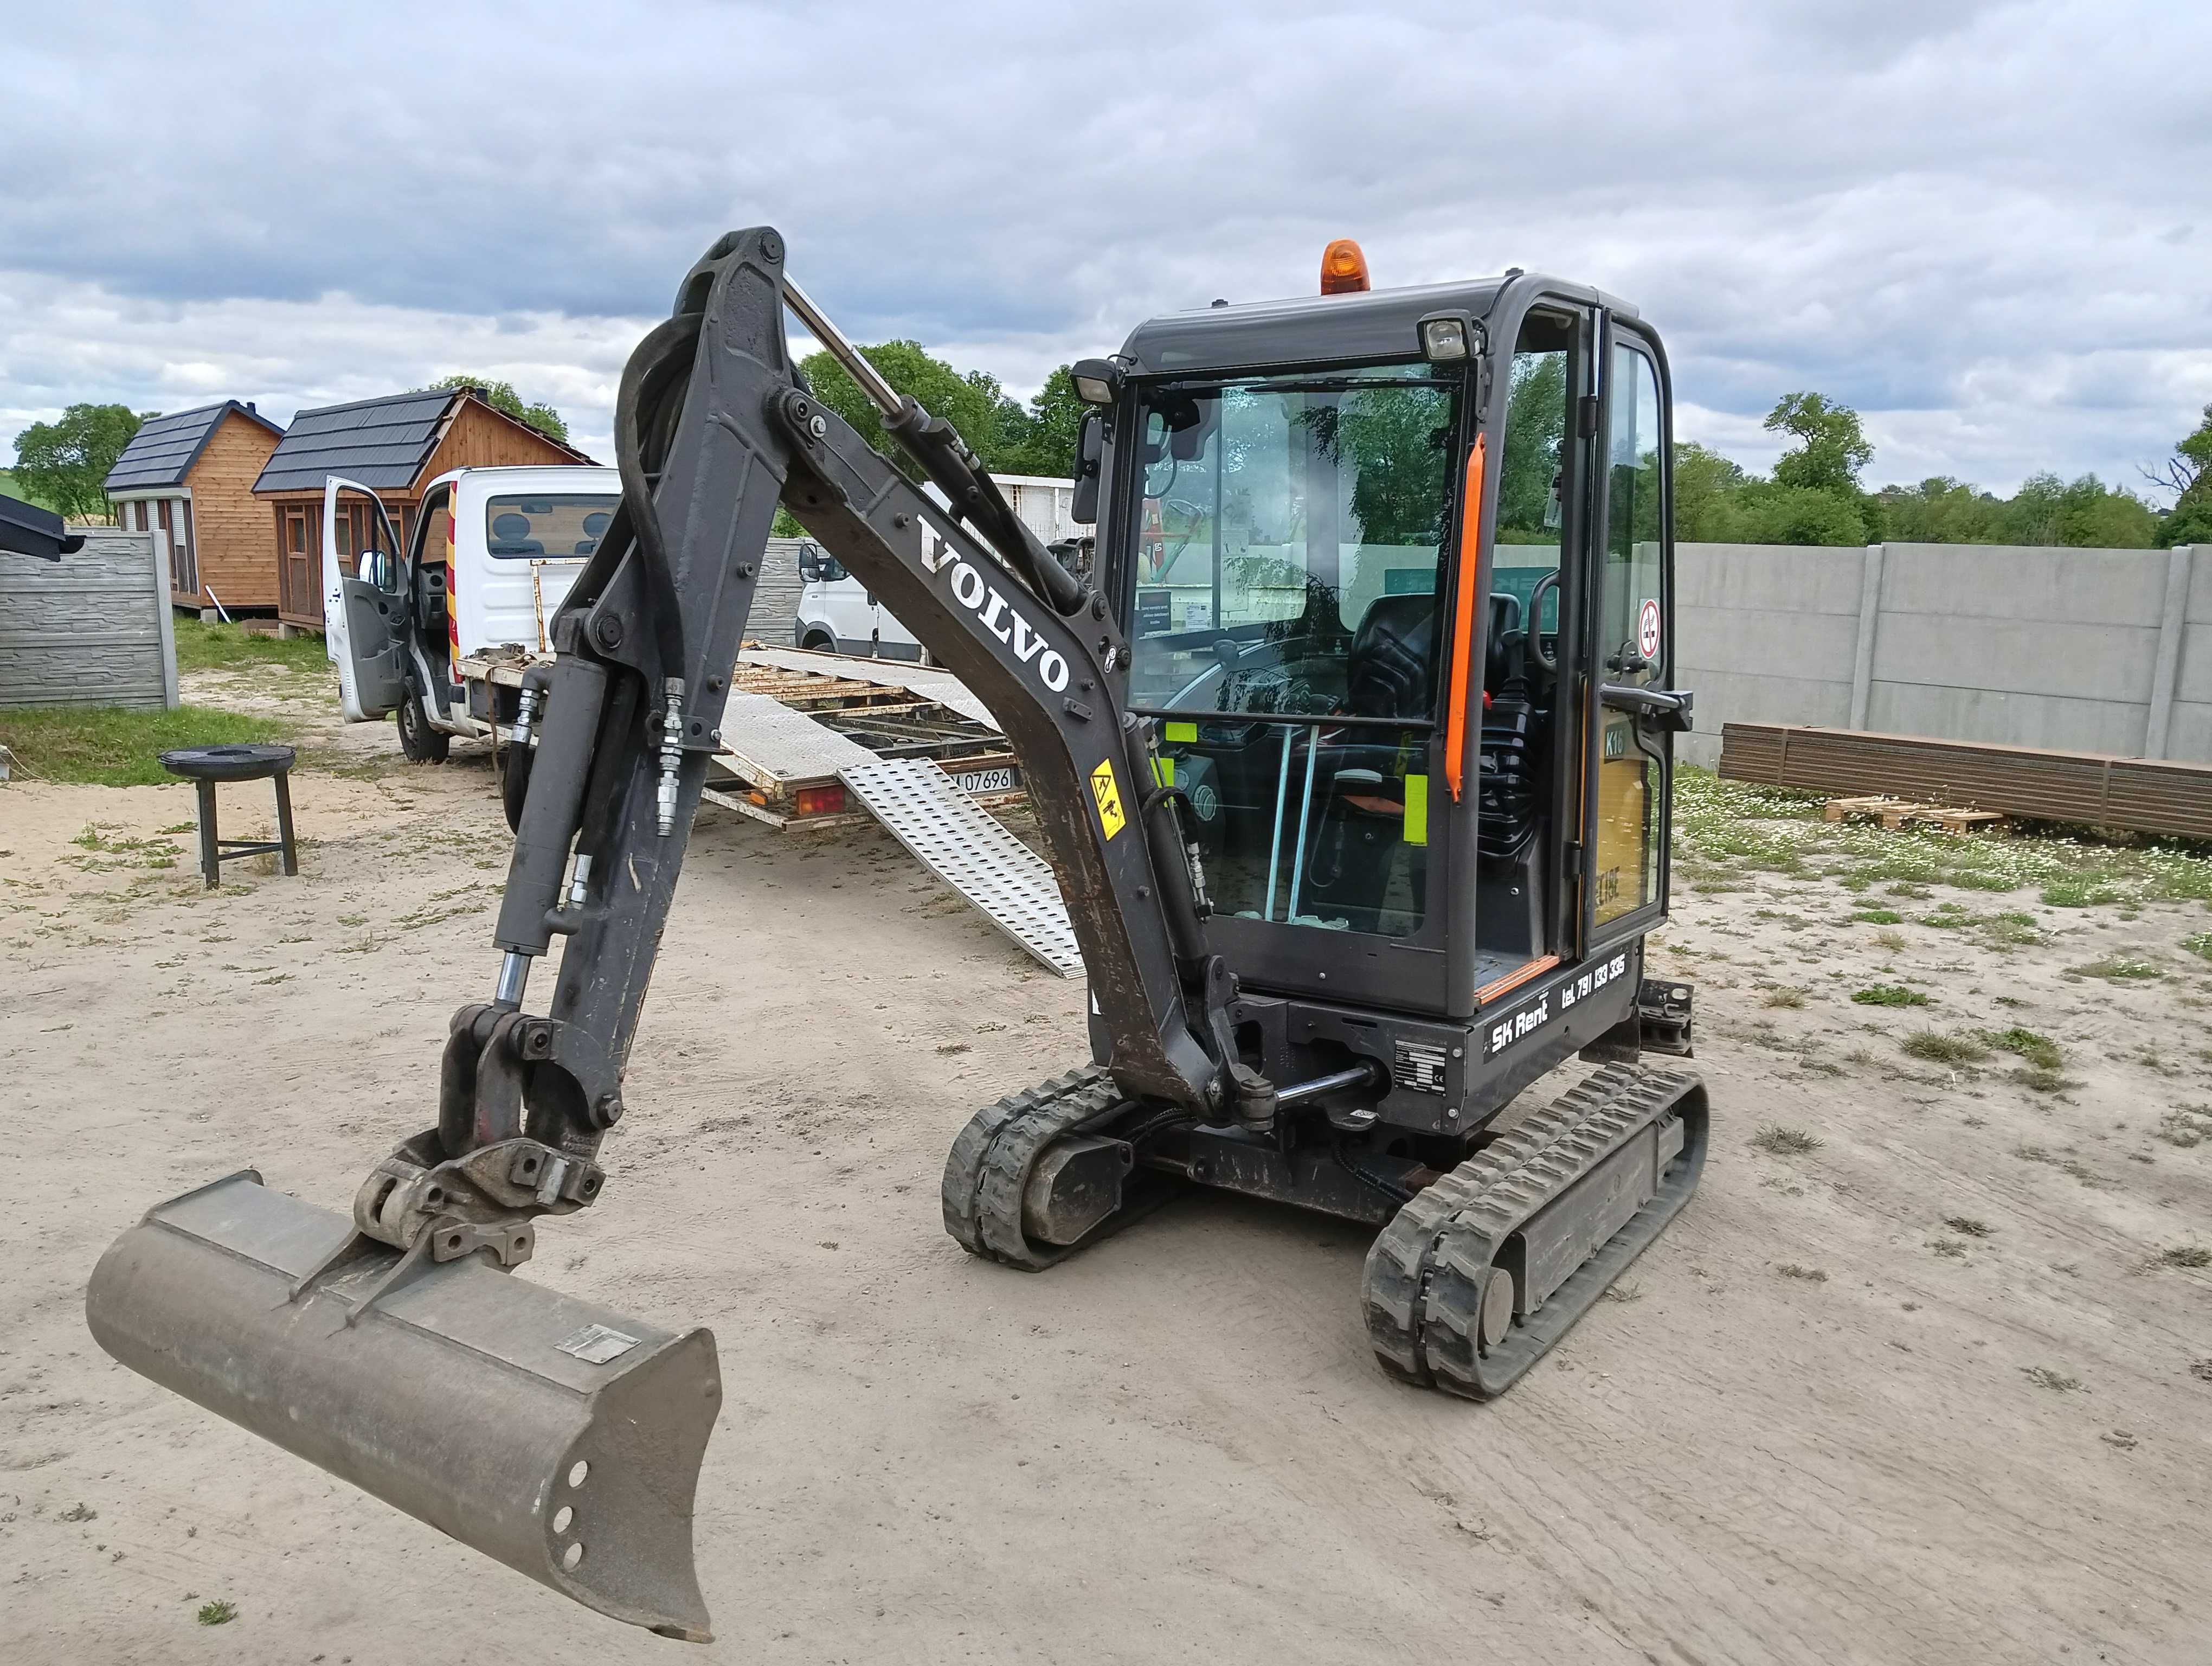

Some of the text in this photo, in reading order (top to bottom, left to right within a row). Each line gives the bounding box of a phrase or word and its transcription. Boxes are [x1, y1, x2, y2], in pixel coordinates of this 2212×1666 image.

[917, 514, 1069, 693] VOLVO
[965, 770, 1008, 791] 07696
[1492, 953, 1625, 1053] SK Rent tel. 791 133 335
